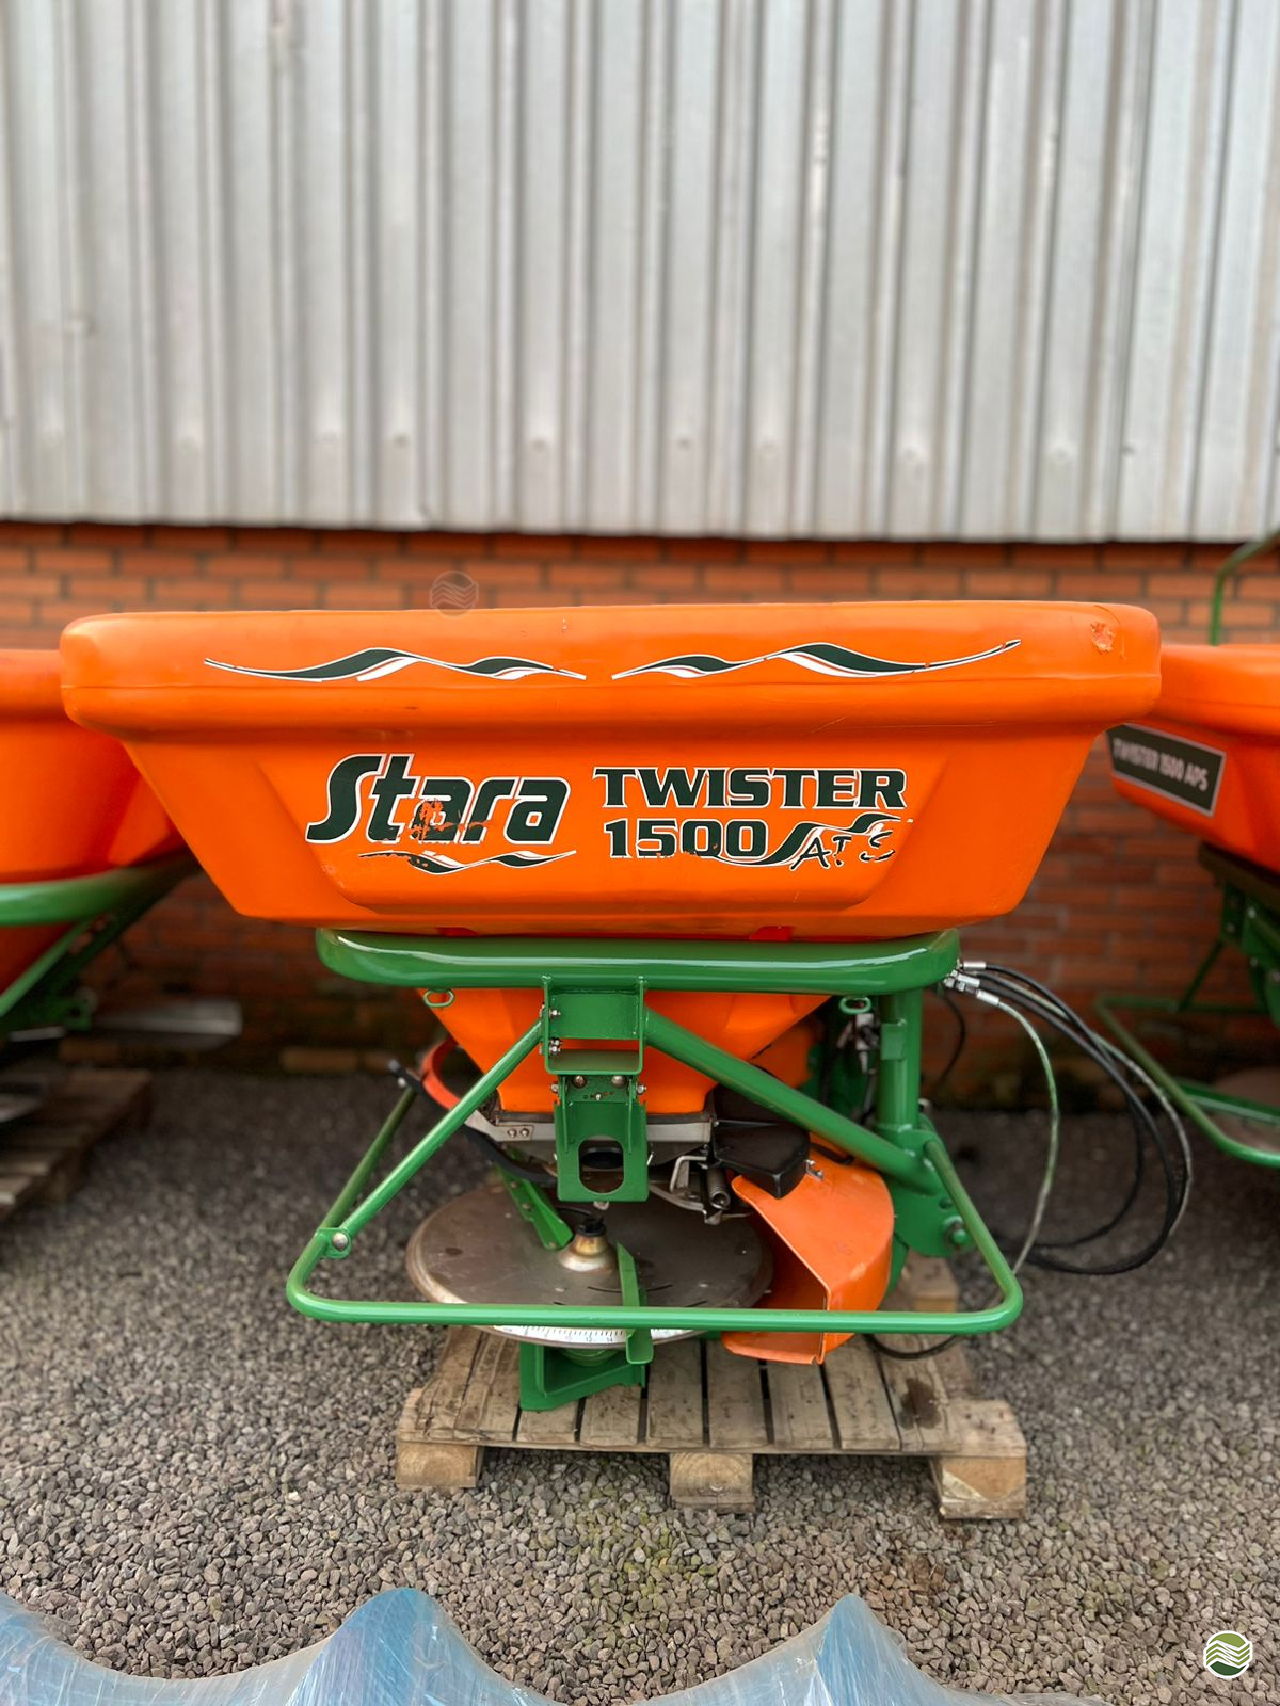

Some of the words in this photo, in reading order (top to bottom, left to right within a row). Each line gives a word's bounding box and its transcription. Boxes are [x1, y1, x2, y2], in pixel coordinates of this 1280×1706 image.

[592, 766, 907, 809] TWISTER
[1184, 762, 1208, 792] APS
[305, 753, 571, 844] Stara
[603, 818, 769, 859] 1500
